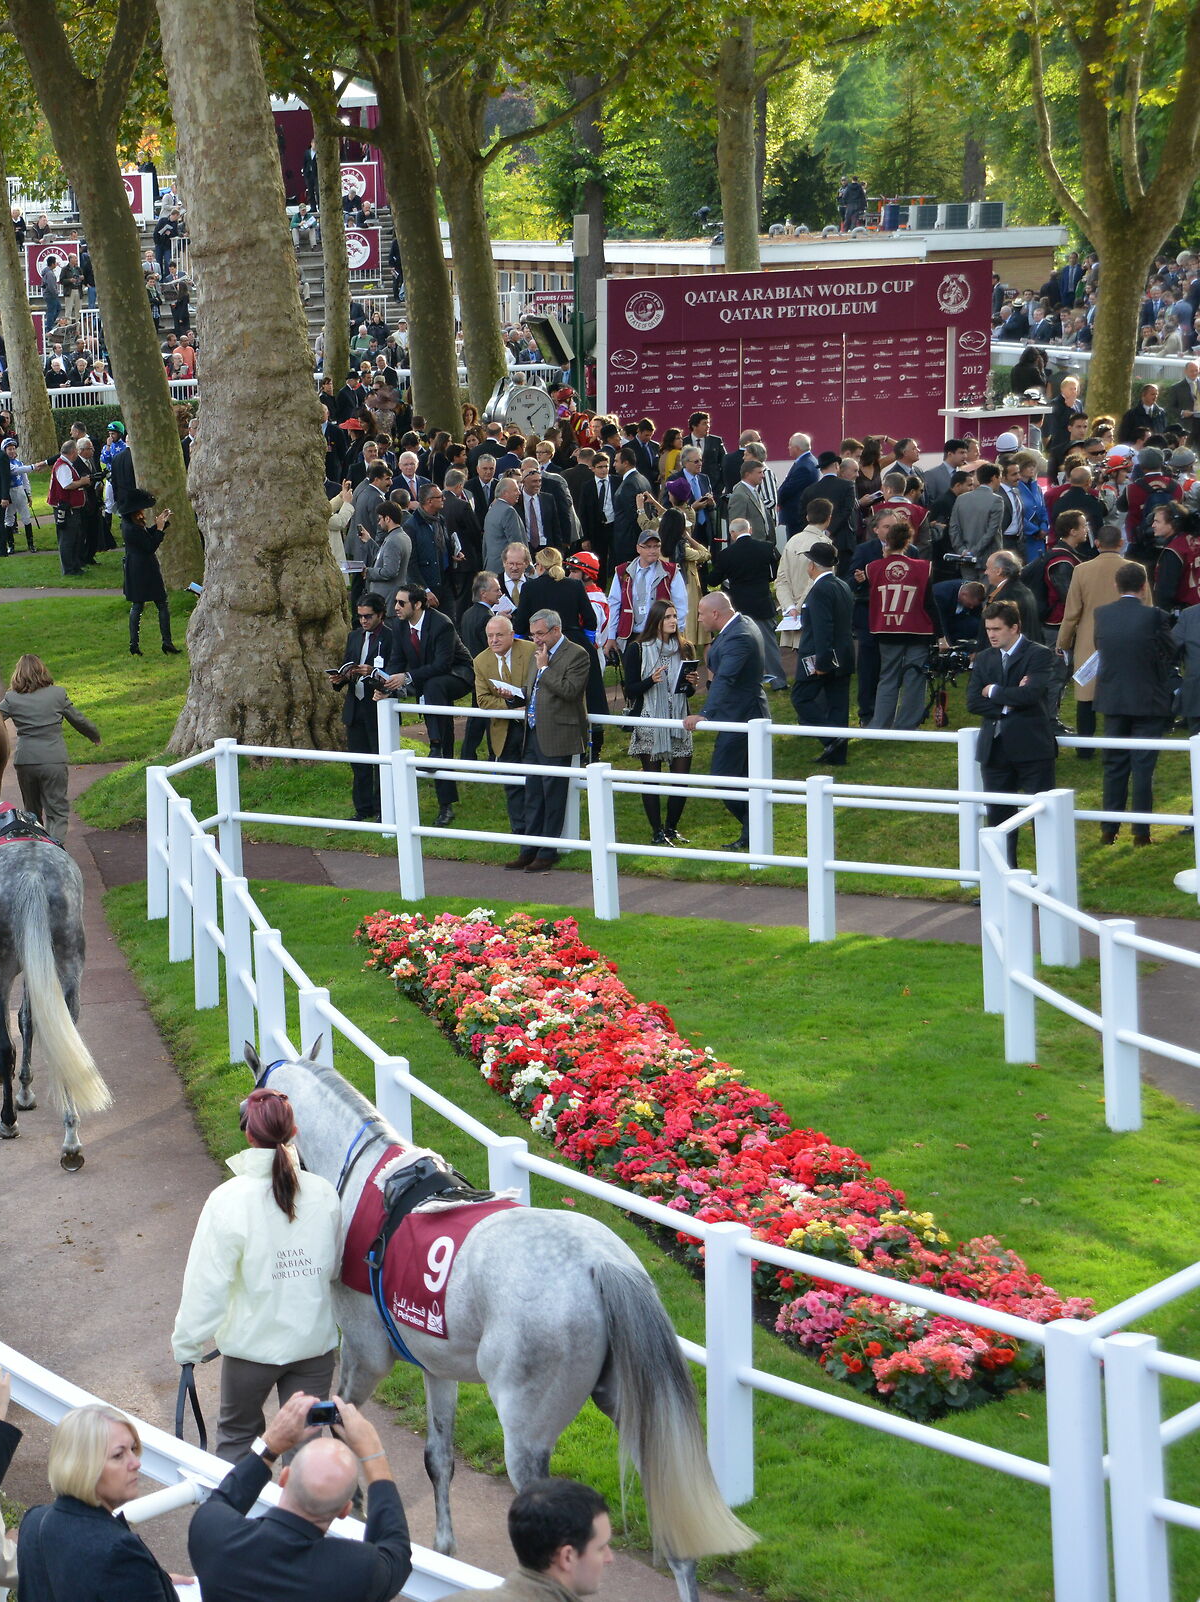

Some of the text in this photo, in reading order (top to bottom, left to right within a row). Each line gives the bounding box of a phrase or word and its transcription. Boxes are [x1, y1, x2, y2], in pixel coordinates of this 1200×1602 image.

[42, 249, 63, 258] QATAR
[684, 280, 914, 306] QATAR ARABIAN WORLD CUP
[719, 301, 877, 323] QATAR PETROLEUM
[962, 366, 983, 375] 2012
[615, 384, 634, 393] 2012
[878, 584, 917, 612] 177
[884, 614, 904, 625] TV
[277, 1249, 304, 1259] QATAR
[424, 1236, 455, 1293] 9
[272, 1267, 322, 1280] WORLD CUP
